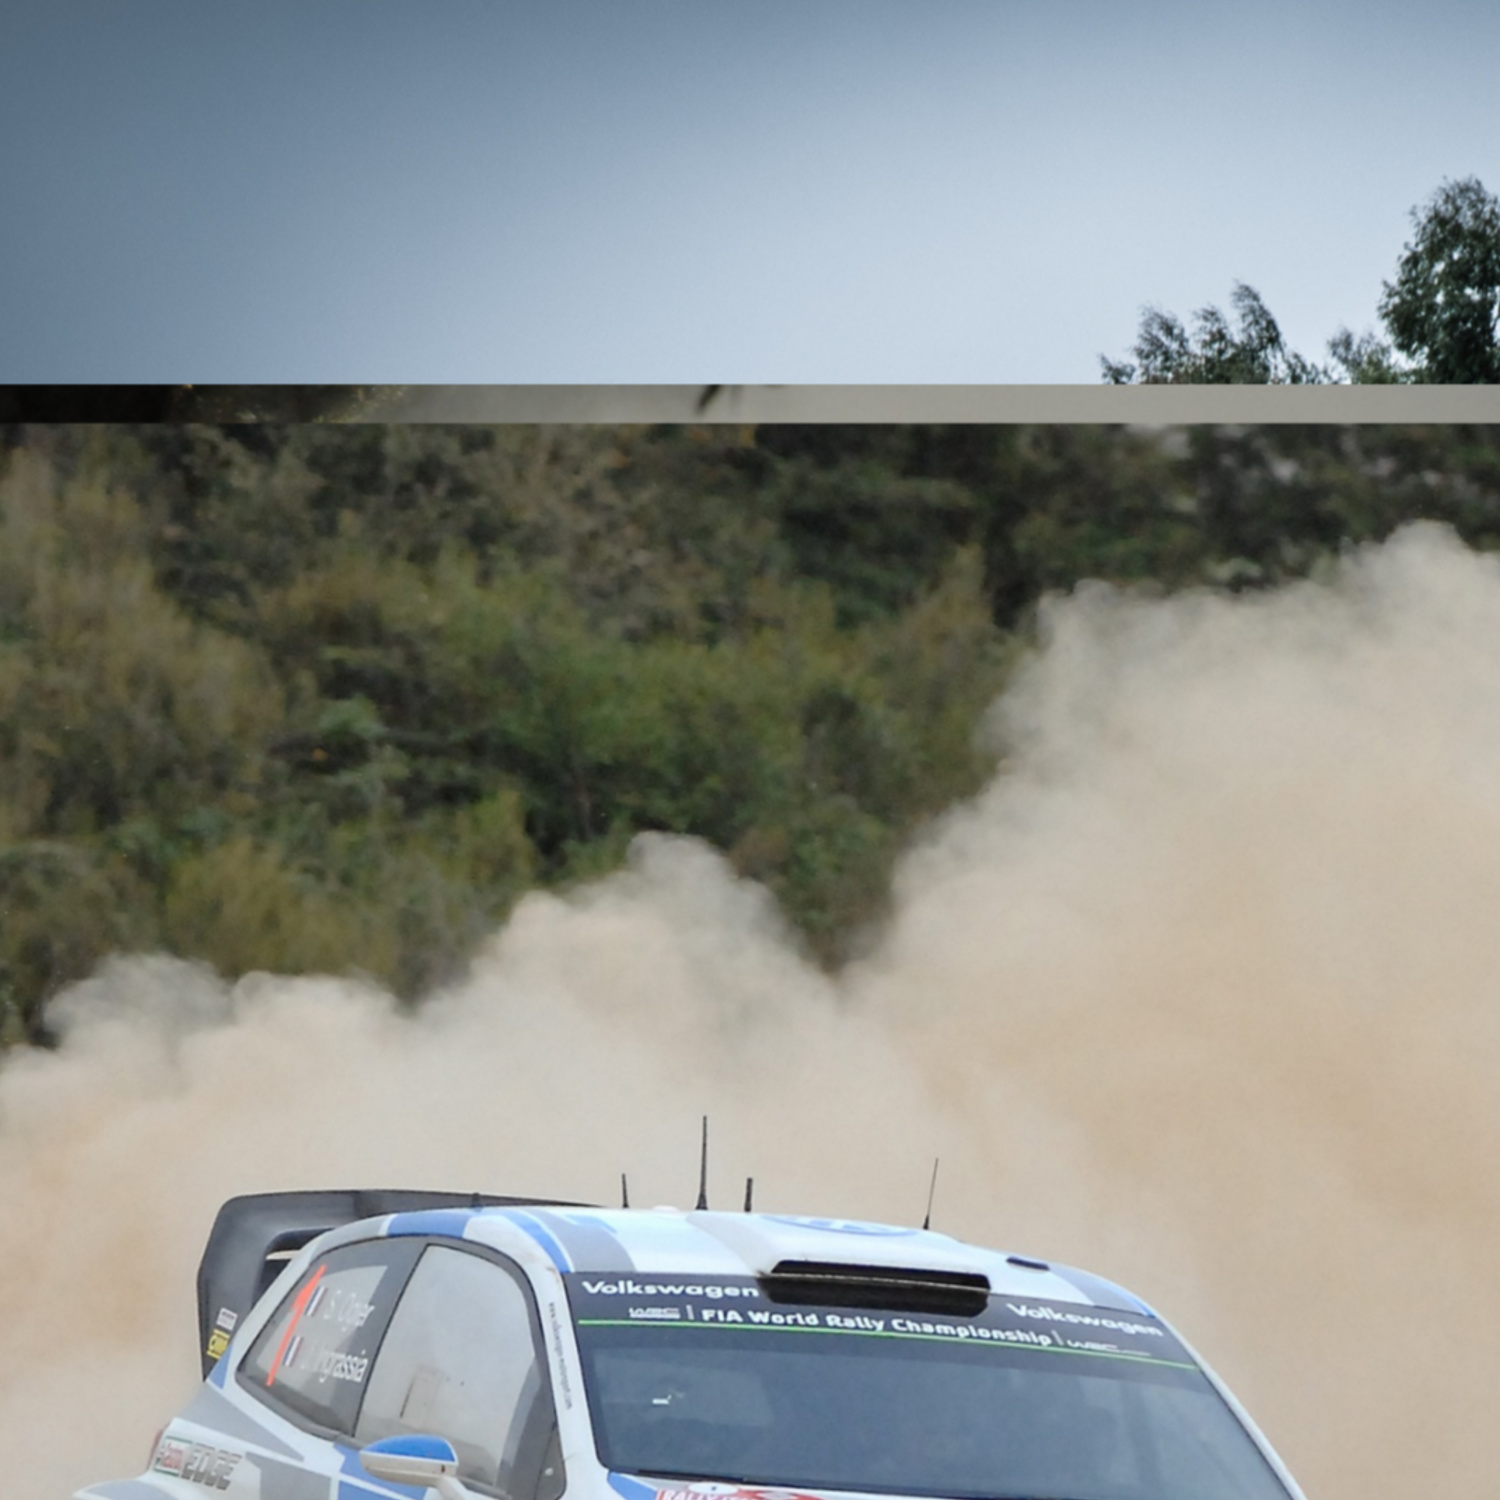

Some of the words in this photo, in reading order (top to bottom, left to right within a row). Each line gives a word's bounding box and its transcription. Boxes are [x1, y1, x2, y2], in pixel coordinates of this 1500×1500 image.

[582, 1280, 760, 1299] Volkswagen
[702, 1309, 743, 1323] FIA
[748, 1310, 819, 1326] World
[826, 1315, 886, 1334] Rally
[891, 1318, 1052, 1346] Championship
[1006, 1303, 1164, 1337] Volkswagen
